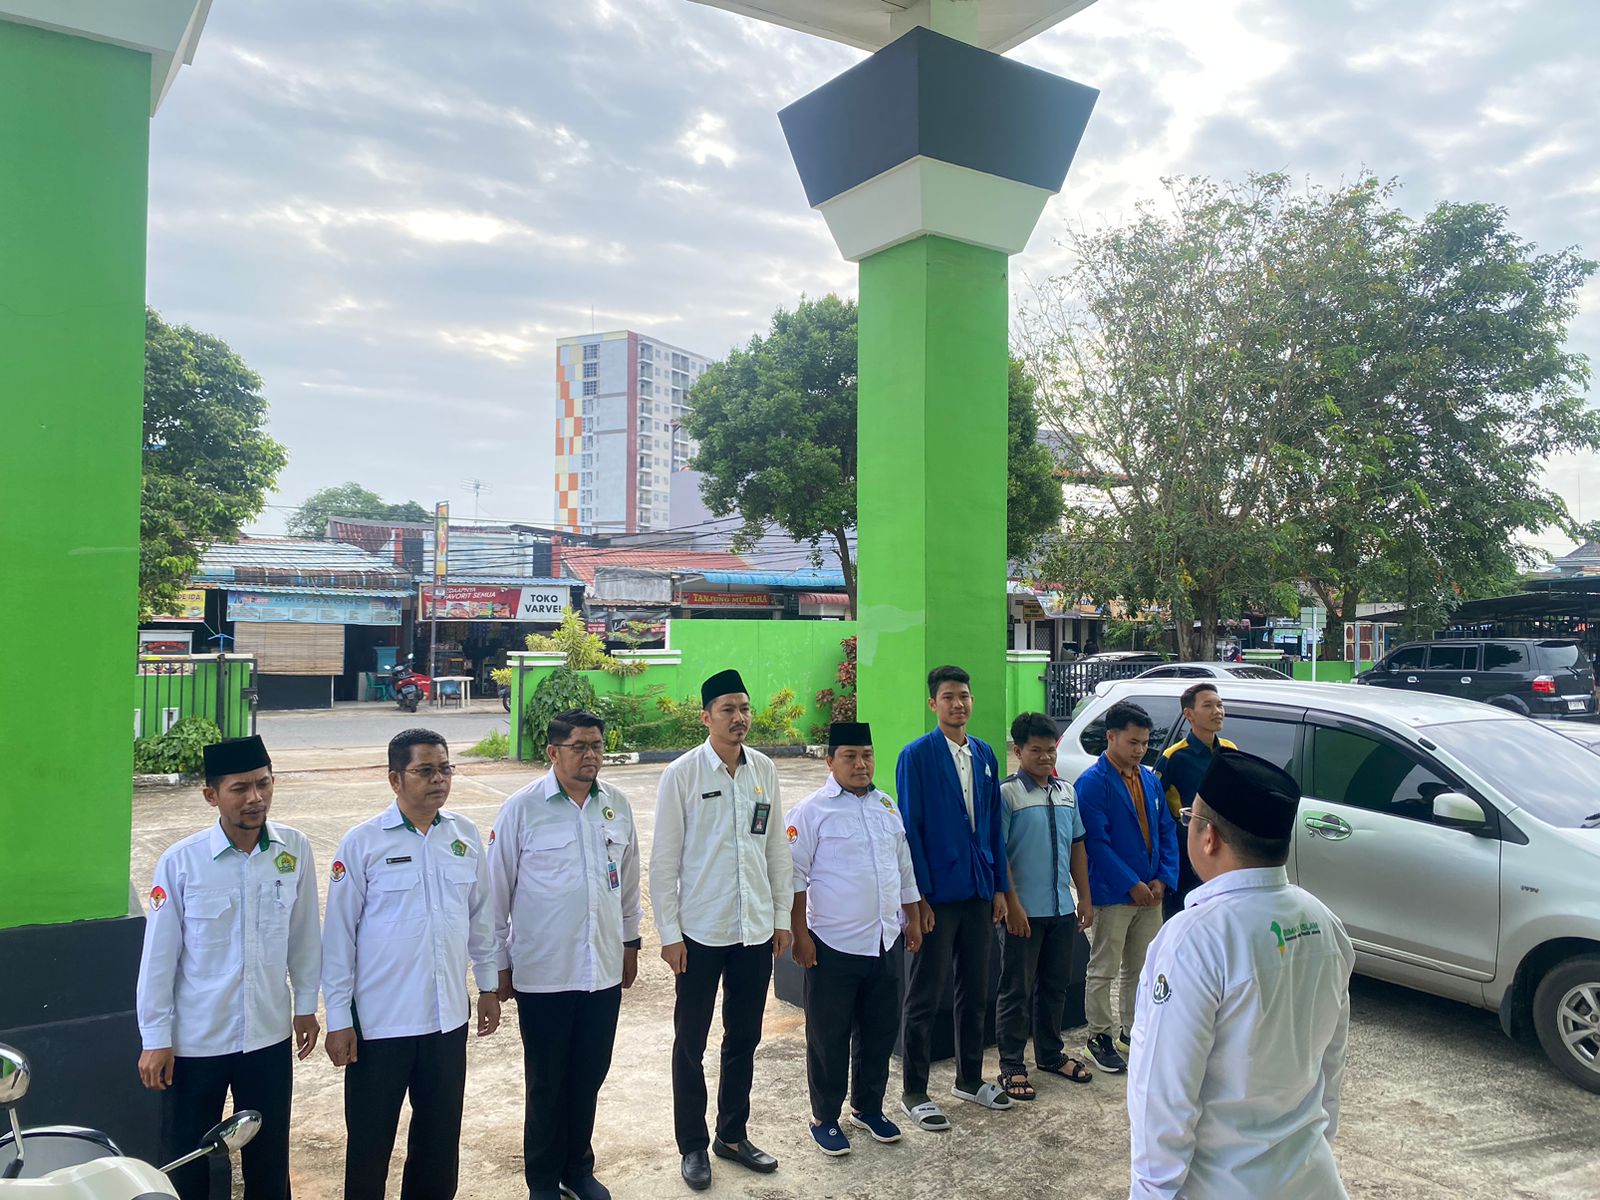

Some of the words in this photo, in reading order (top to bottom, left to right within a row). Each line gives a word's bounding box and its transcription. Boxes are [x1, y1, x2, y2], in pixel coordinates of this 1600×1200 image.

[472, 591, 496, 599] SEMUA
[530, 594, 559, 603] TOKO
[693, 593, 730, 603] TANJUNG
[731, 594, 768, 603] MUTIARA
